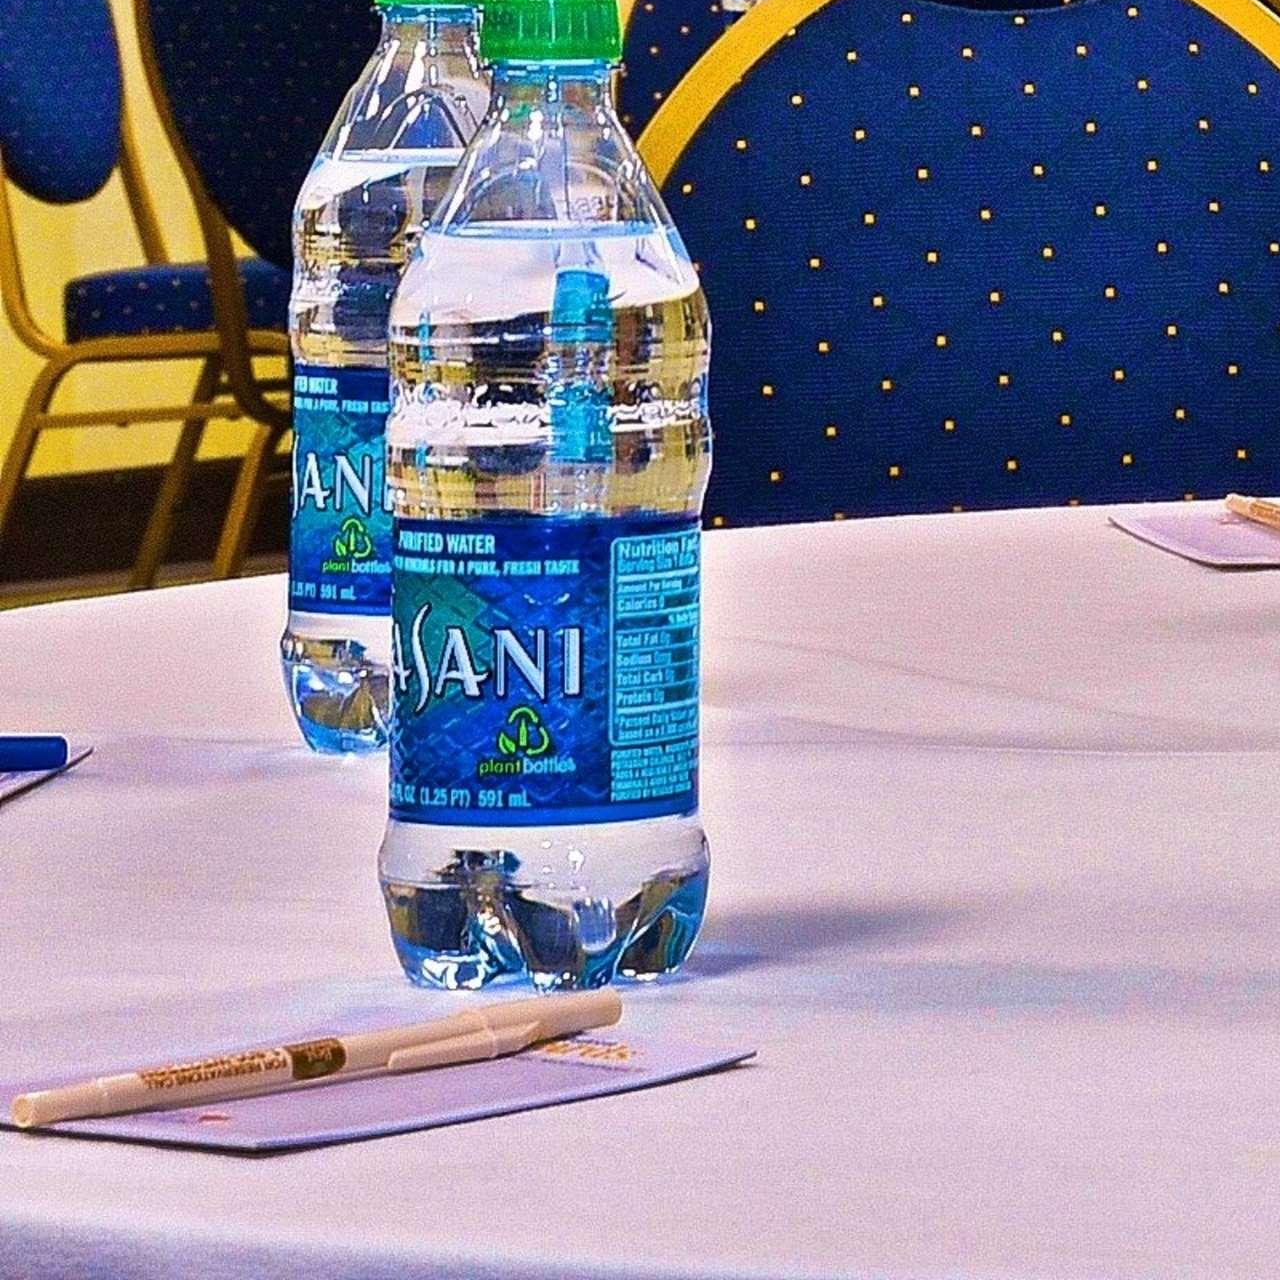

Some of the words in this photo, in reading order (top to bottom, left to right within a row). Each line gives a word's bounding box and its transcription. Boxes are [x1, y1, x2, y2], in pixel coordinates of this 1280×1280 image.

[446, 533, 496, 555] WATER
[619, 539, 679, 559] Nutrition
[450, 789, 471, 808] PT)
[478, 789, 504, 807] 591
[508, 790, 532, 807] mL
